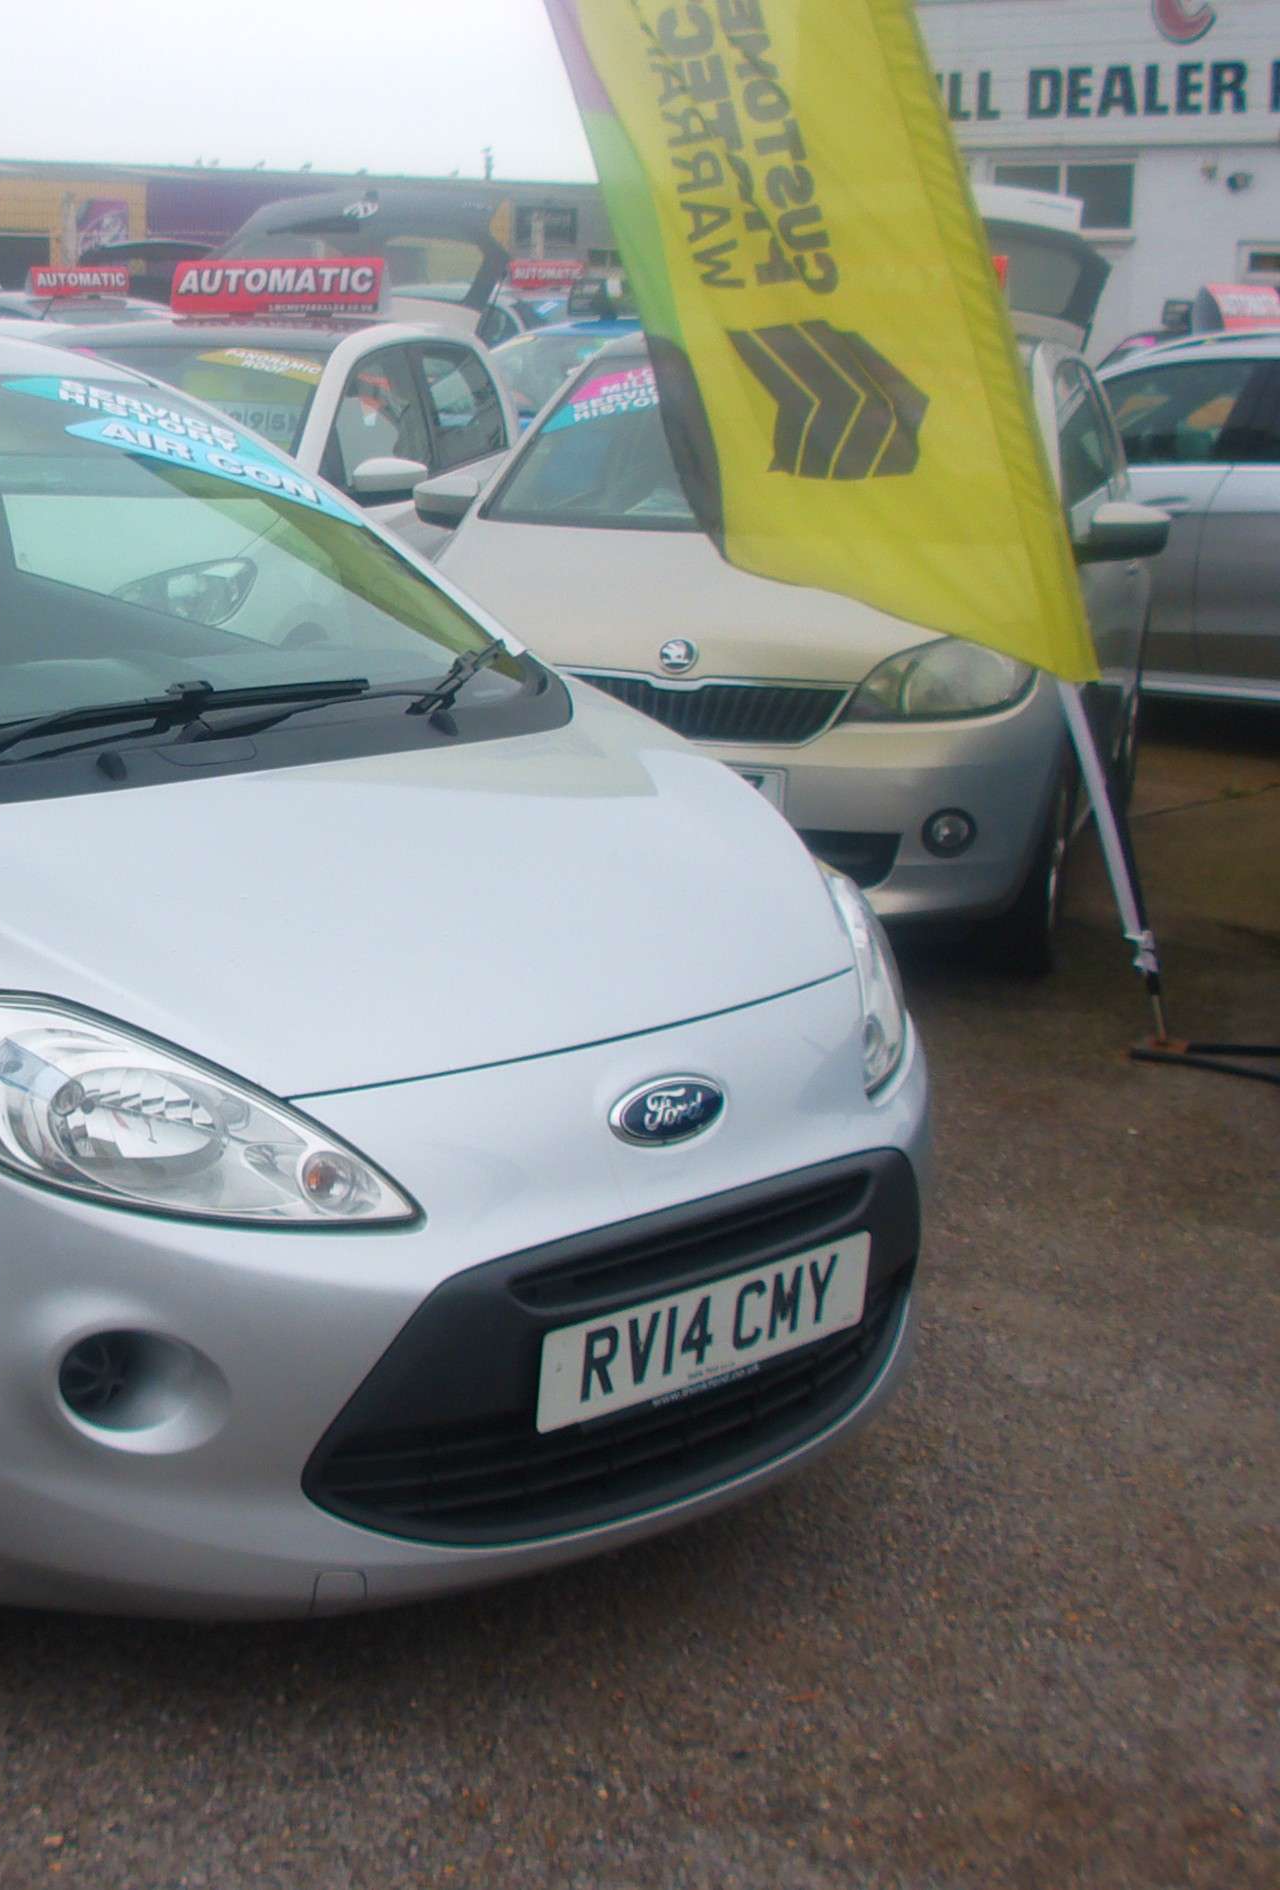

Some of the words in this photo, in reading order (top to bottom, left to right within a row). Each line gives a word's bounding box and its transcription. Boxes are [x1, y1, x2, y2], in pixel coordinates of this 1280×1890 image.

[936, 71, 1001, 121] LL
[1027, 60, 1248, 119] DEALER
[37, 271, 126, 288] AUTOMATIC
[177, 266, 374, 294] AUTOMATIC
[224, 349, 322, 375] PANORAMIC
[601, 376, 657, 394] MILE
[59, 379, 236, 442] SERVICE
[59, 389, 240, 453] HISTORY
[574, 396, 659, 422] HISTO
[101, 421, 196, 463] AIR
[206, 451, 321, 505] CON
[643, 1088, 703, 1131] Ford
[579, 1296, 714, 1403] RV14
[731, 1253, 840, 1351] CMY
